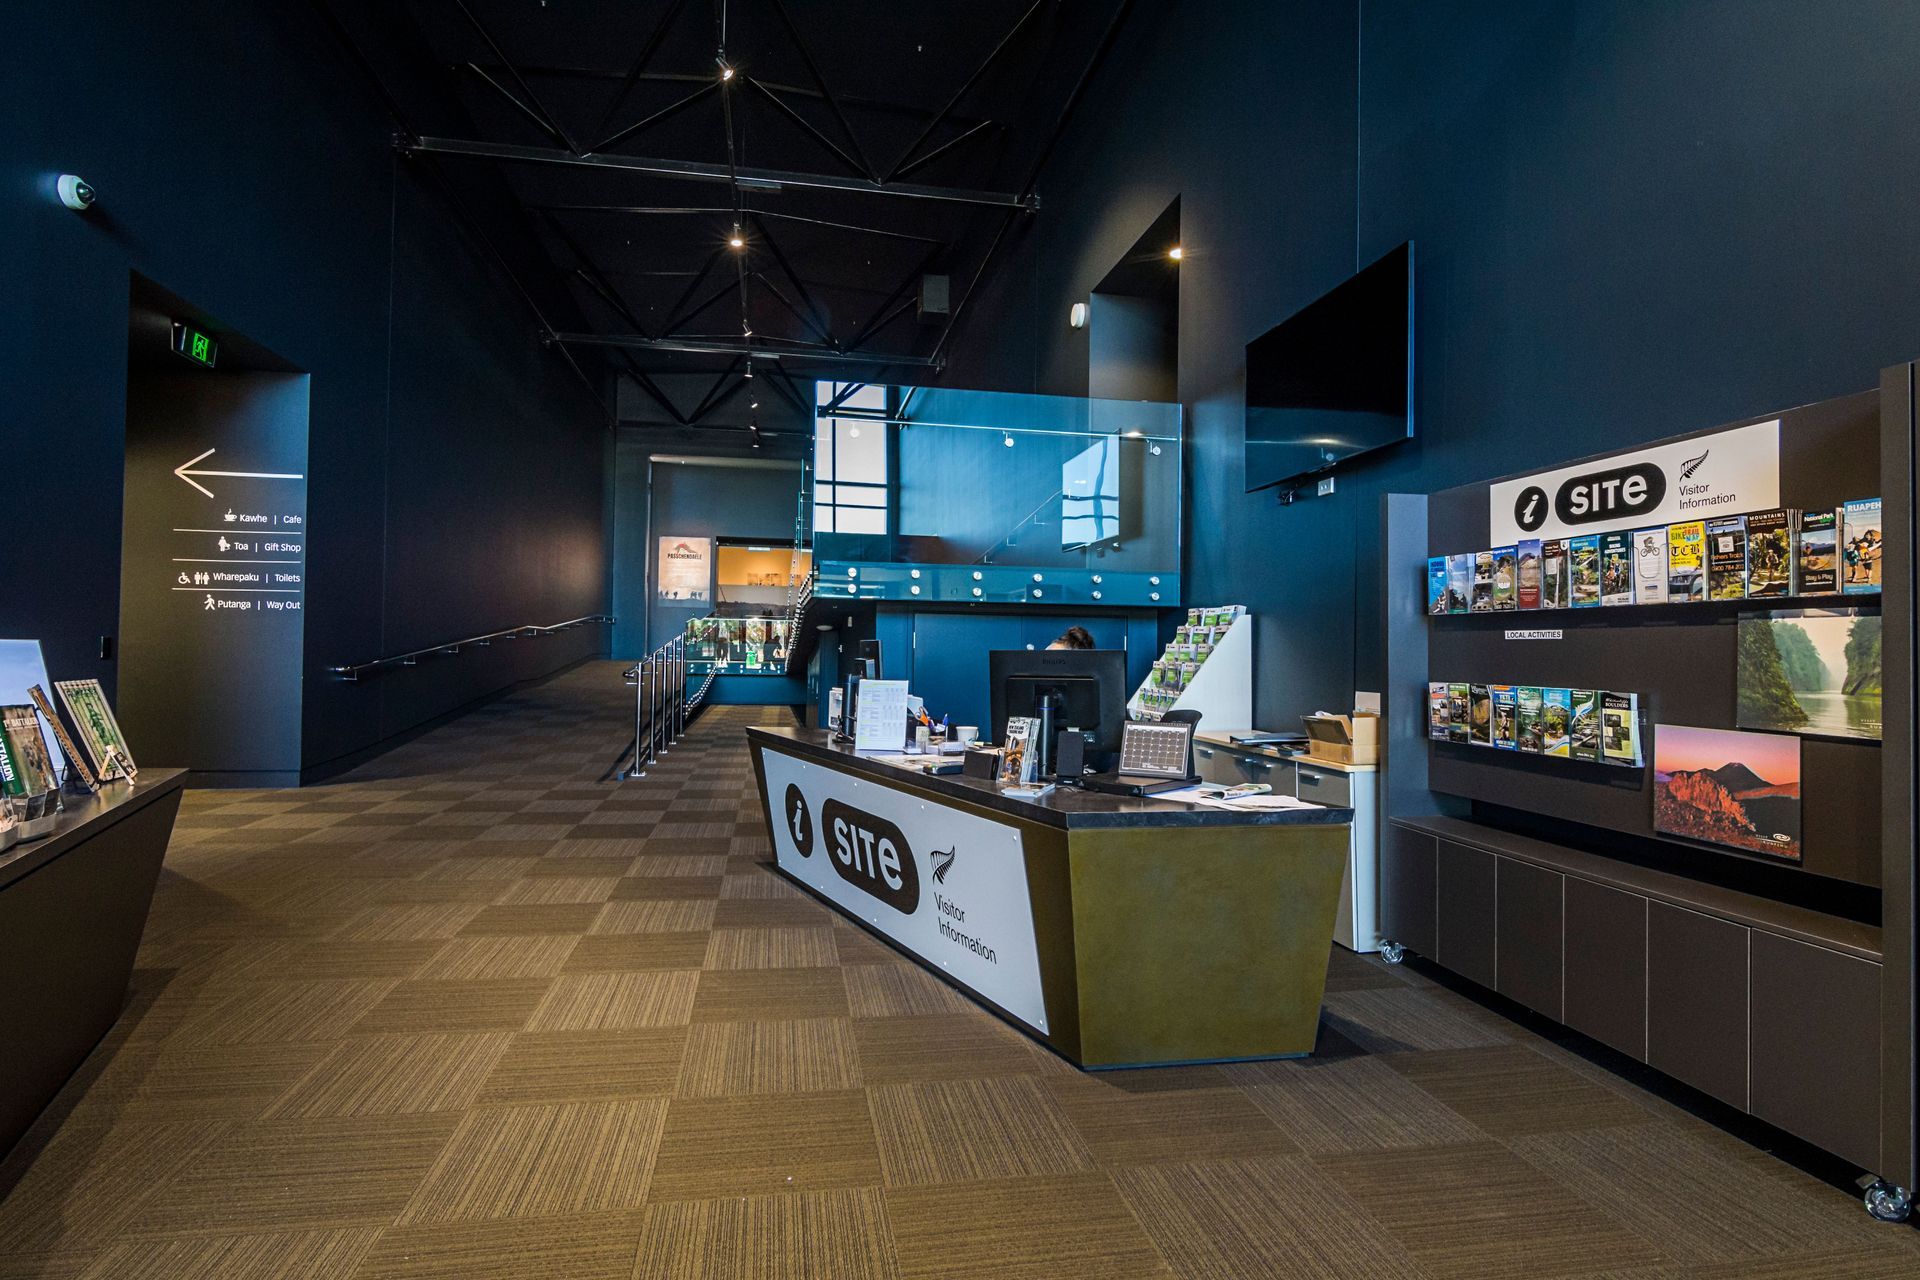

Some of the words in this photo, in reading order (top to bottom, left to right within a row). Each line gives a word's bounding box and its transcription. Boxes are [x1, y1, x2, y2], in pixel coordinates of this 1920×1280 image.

[1679, 482, 1710, 497] Visitor
[1679, 493, 1736, 510] Information
[240, 514, 268, 523] Kawhe
[283, 515, 302, 524] Cafe
[1750, 512, 1785, 521] MOUNTAINS
[1671, 531, 1685, 541] BIKE
[234, 542, 249, 550] Toa
[264, 543, 279, 551] Gift
[281, 543, 301, 553] Shop
[1671, 544, 1700, 556] TCB
[213, 572, 259, 582] Wharepaku
[275, 574, 300, 582] Toilets
[218, 600, 251, 610] Putanga
[267, 601, 284, 610] Way
[286, 601, 300, 609] Out
[934, 892, 965, 923] Visitor
[938, 917, 997, 965] Information
